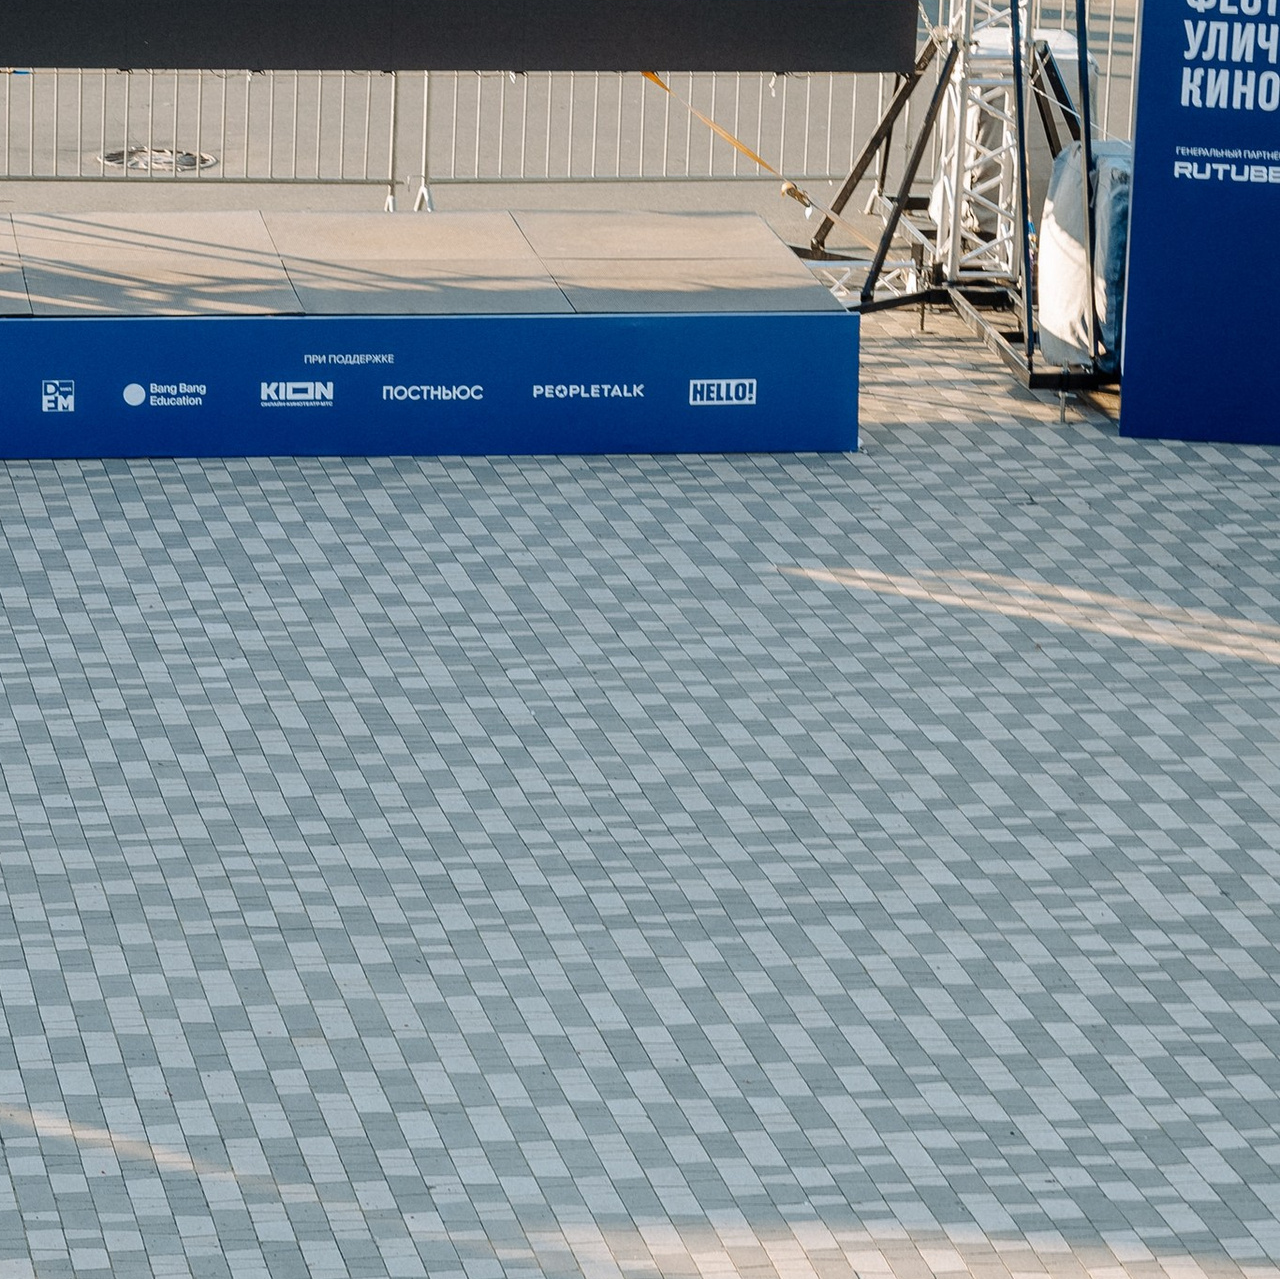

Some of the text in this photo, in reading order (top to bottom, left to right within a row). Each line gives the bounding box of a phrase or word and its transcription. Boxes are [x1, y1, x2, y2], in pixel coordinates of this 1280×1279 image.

[1183, 19, 1280, 64] УЛИЧ
[1180, 66, 1280, 112] КИНО
[1175, 145, 1242, 159] ГЕНЕРАЛЬНЫЙ
[1173, 160, 1280, 184] RUTUBE
[304, 353, 395, 365] ПРИ ПОДДЕРЖКЕ
[149, 382, 207, 396] Bang Bang
[260, 381, 334, 401] KION
[382, 384, 484, 401] ПОСТНЬЮС
[532, 383, 645, 399] PEOPLETALK
[691, 381, 755, 403] HELLO!
[149, 395, 203, 406] Education
